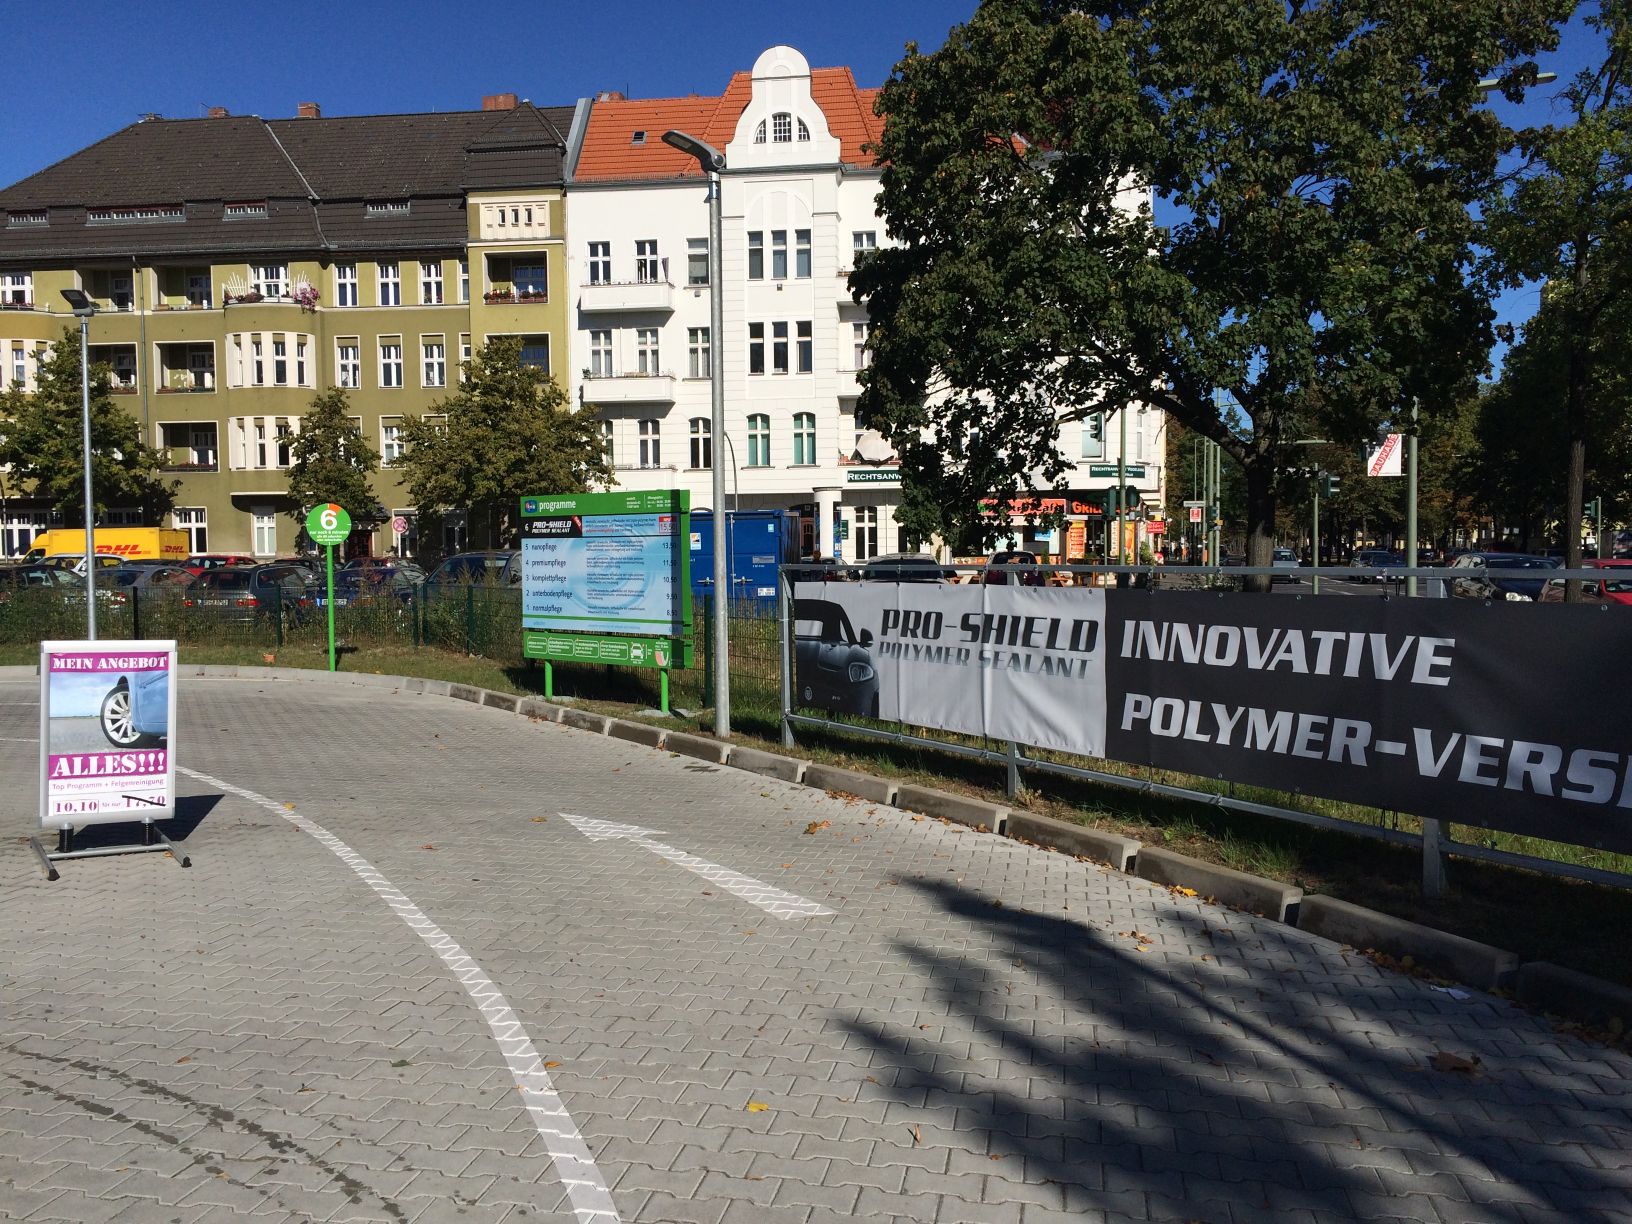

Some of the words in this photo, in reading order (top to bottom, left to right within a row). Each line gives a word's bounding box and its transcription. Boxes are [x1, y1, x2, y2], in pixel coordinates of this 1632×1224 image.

[1369, 434, 1398, 476] BAUHAUS
[540, 501, 576, 512] programme
[320, 509, 337, 530] 6
[532, 521, 572, 529] PRO-SHIELD
[96, 545, 142, 554] DHL
[532, 543, 557, 552] nanopflege
[532, 559, 566, 568] premiumpflege
[532, 574, 567, 583] komplettpflege
[533, 590, 573, 599] unterbodenpflege
[881, 609, 1099, 653] PRO-SHIELD
[1120, 620, 1455, 686] INNOVATIVE
[53, 658, 93, 669] MEIN
[97, 656, 167, 669] ANGEBOT
[878, 641, 970, 667] POLYMER
[978, 650, 1093, 679] SEALANT
[52, 752, 165, 777] ALLES!!!
[67, 782, 102, 790] Programm
[111, 778, 164, 787] Felgenreinigung
